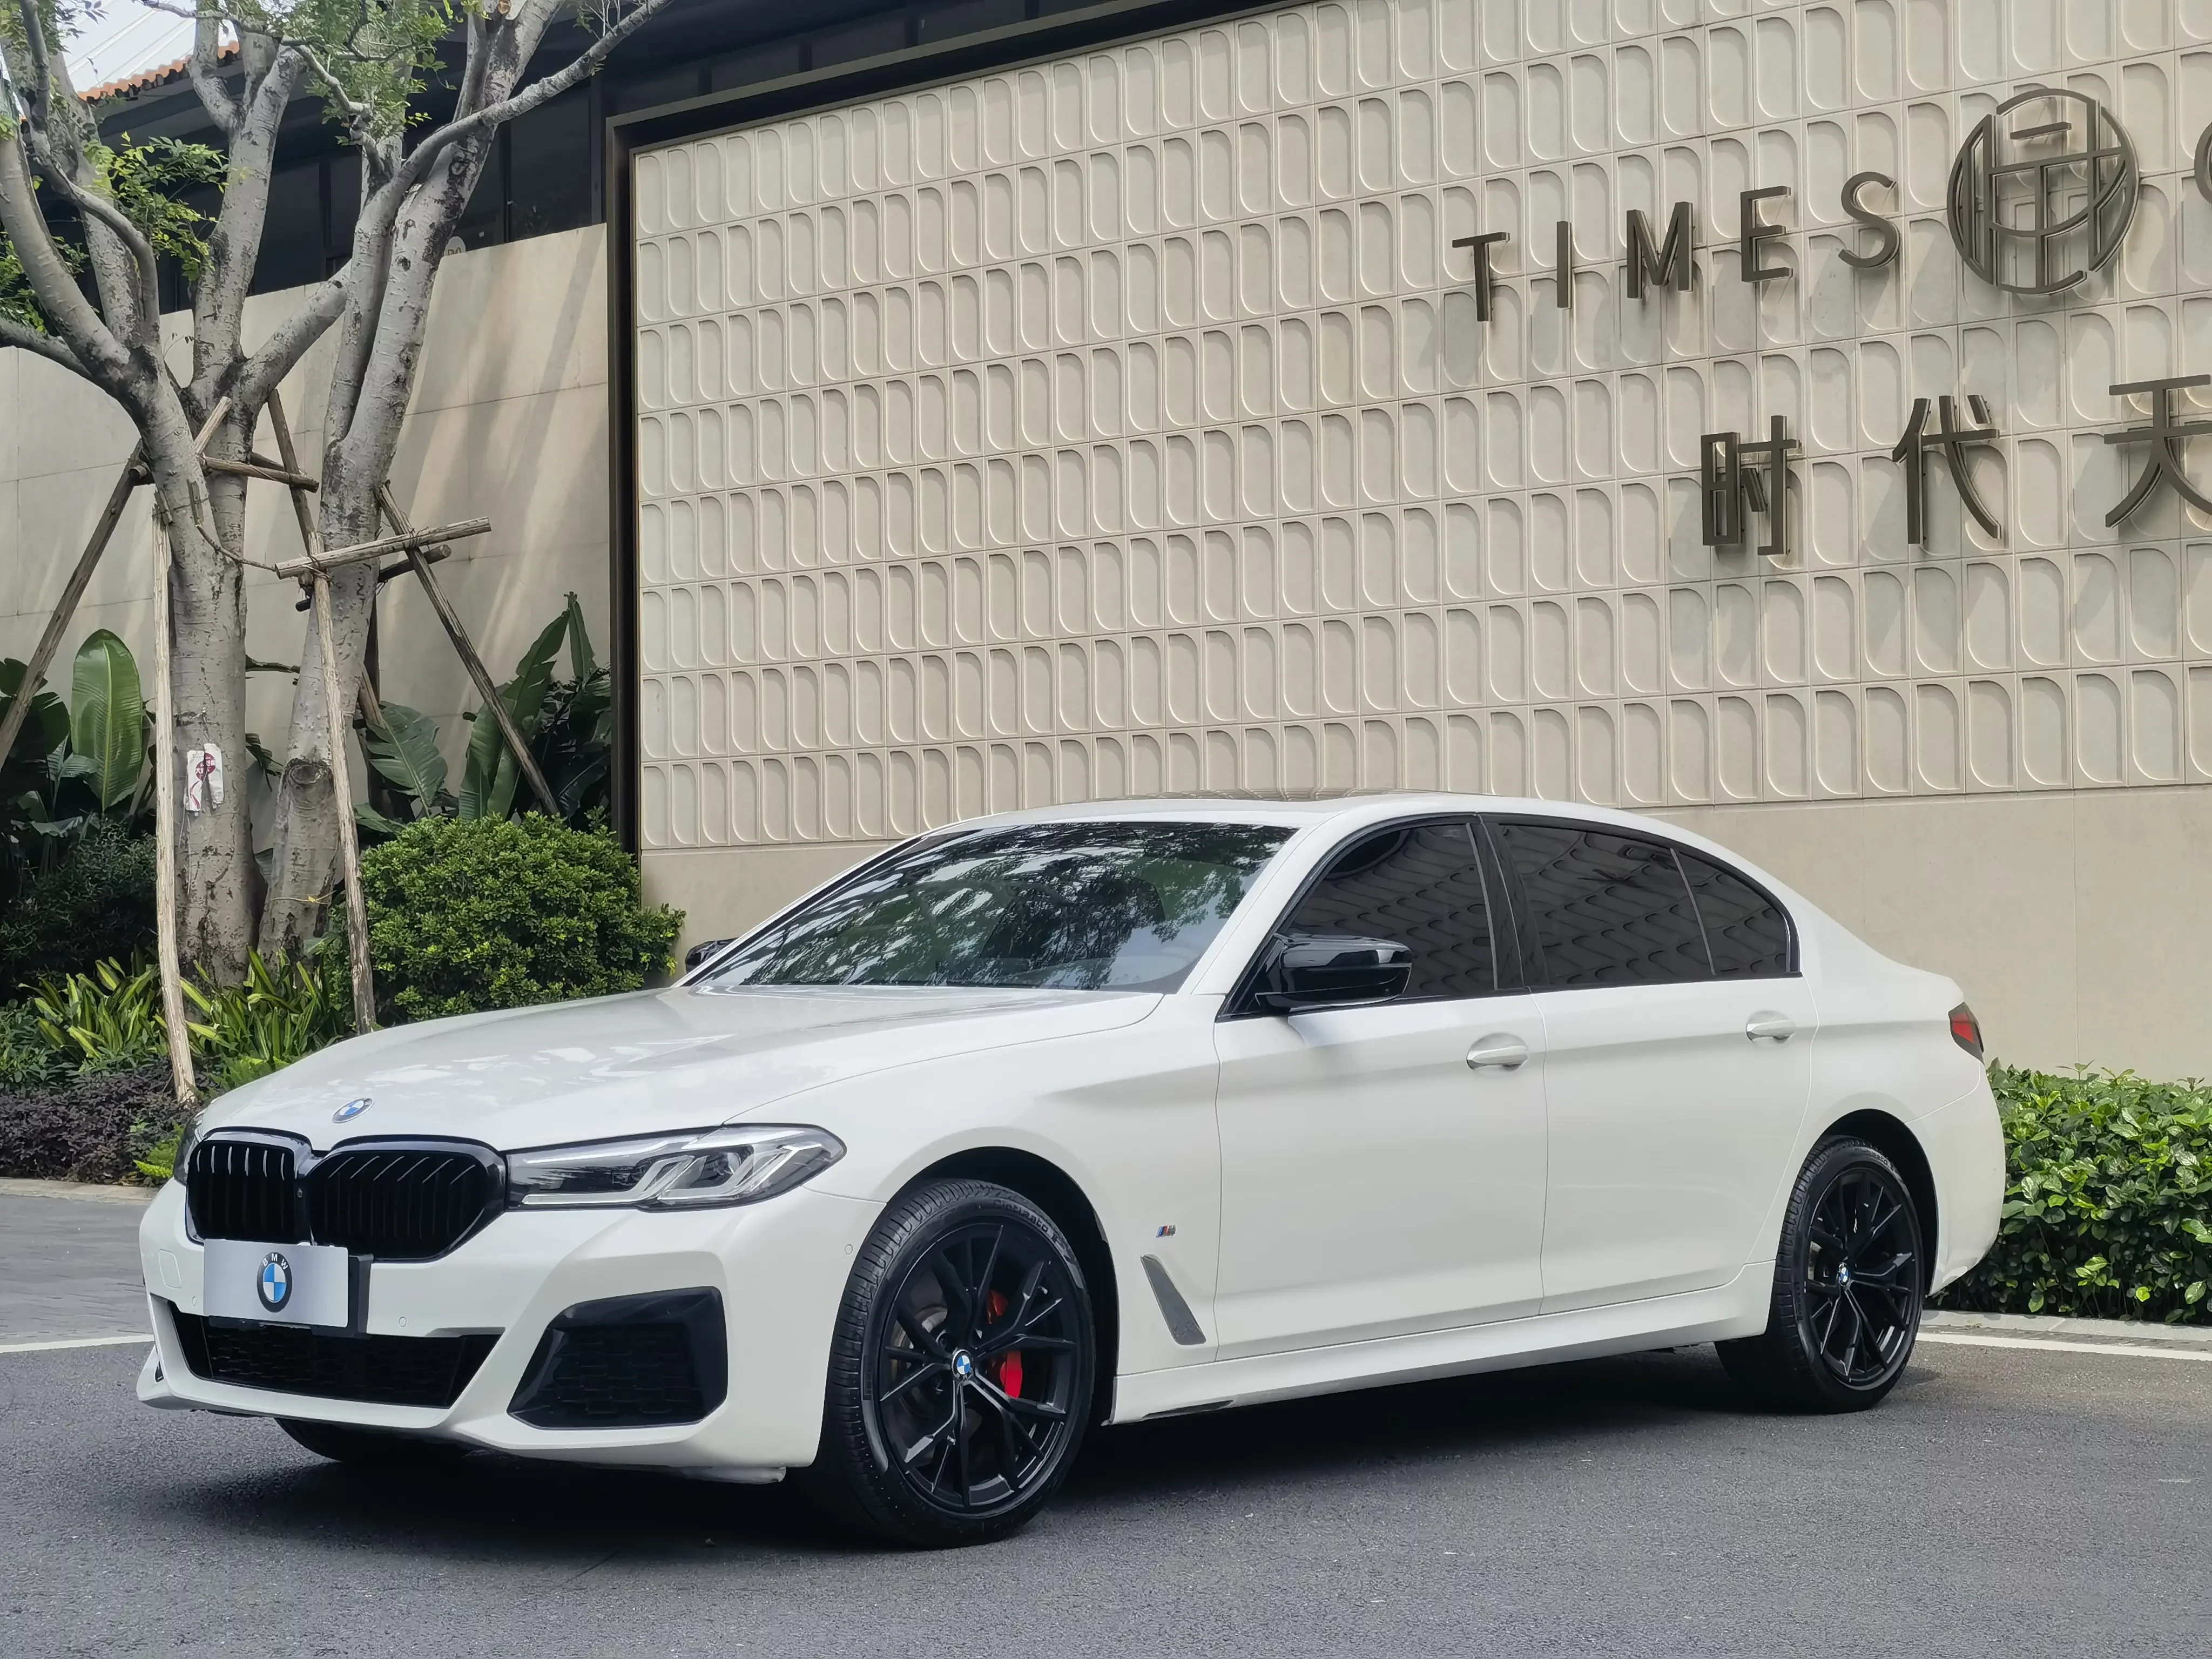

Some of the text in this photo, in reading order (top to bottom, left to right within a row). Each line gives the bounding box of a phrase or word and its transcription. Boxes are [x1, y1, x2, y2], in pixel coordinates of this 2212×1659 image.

[1453, 172, 1900, 322] TIMES
[1701, 374, 2212, 556] 时代天
[262, 1253, 288, 1270] BMW
